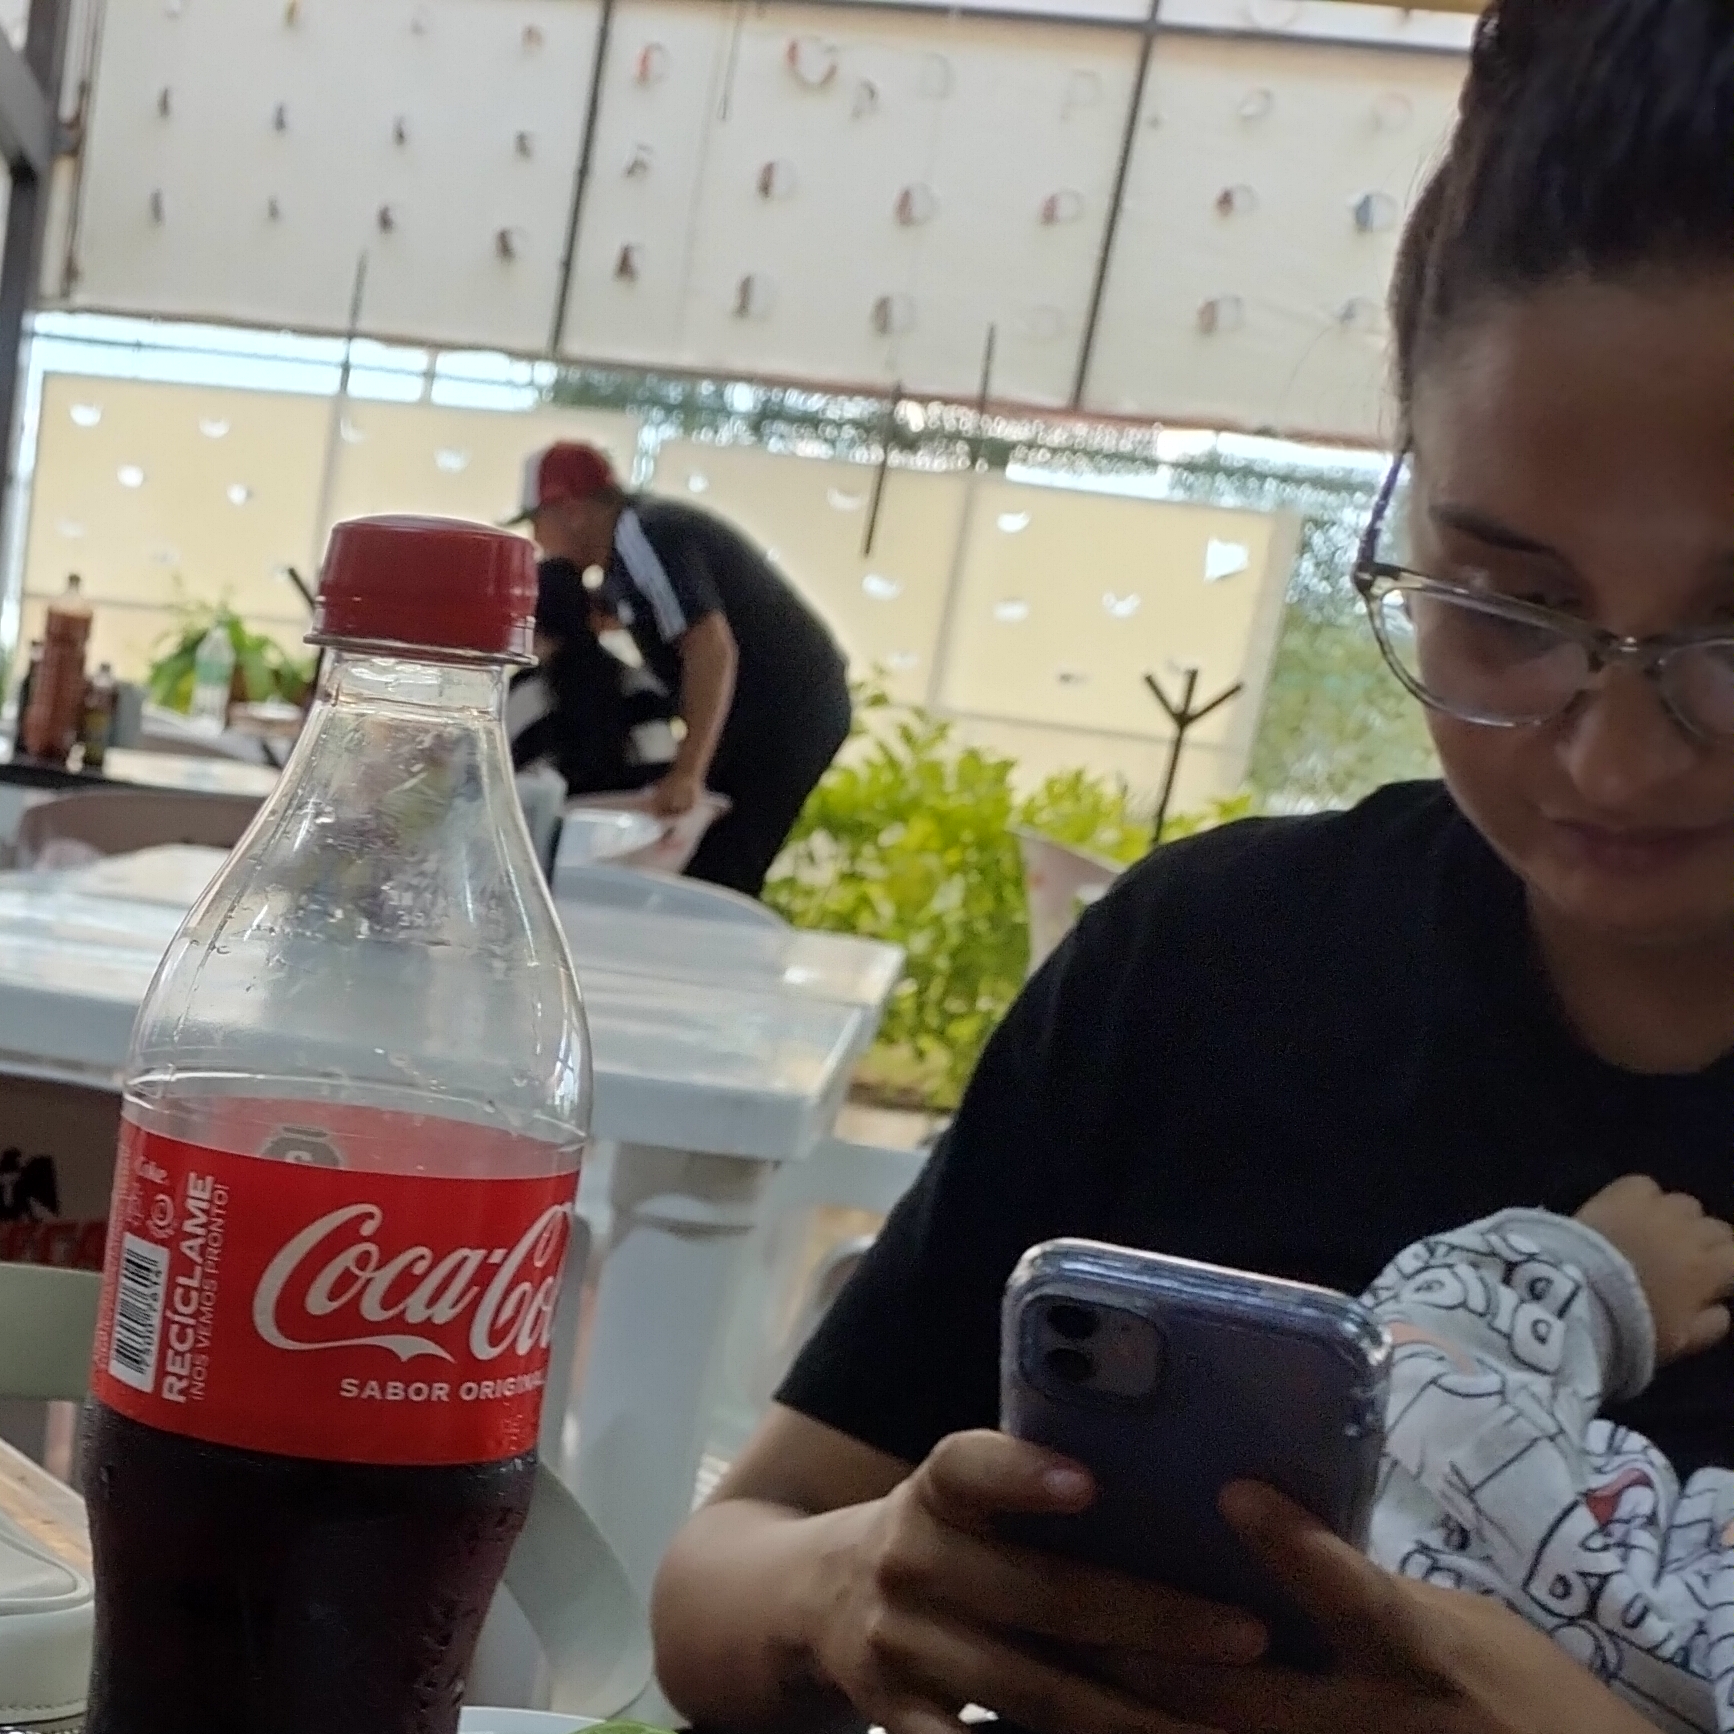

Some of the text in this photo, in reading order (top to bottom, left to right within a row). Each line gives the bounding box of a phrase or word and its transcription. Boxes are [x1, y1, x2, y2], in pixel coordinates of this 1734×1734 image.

[162, 1171, 216, 1404] RECÍCLAME
[194, 1281, 220, 1348] VEMOS
[339, 1378, 451, 1402] SABOR
